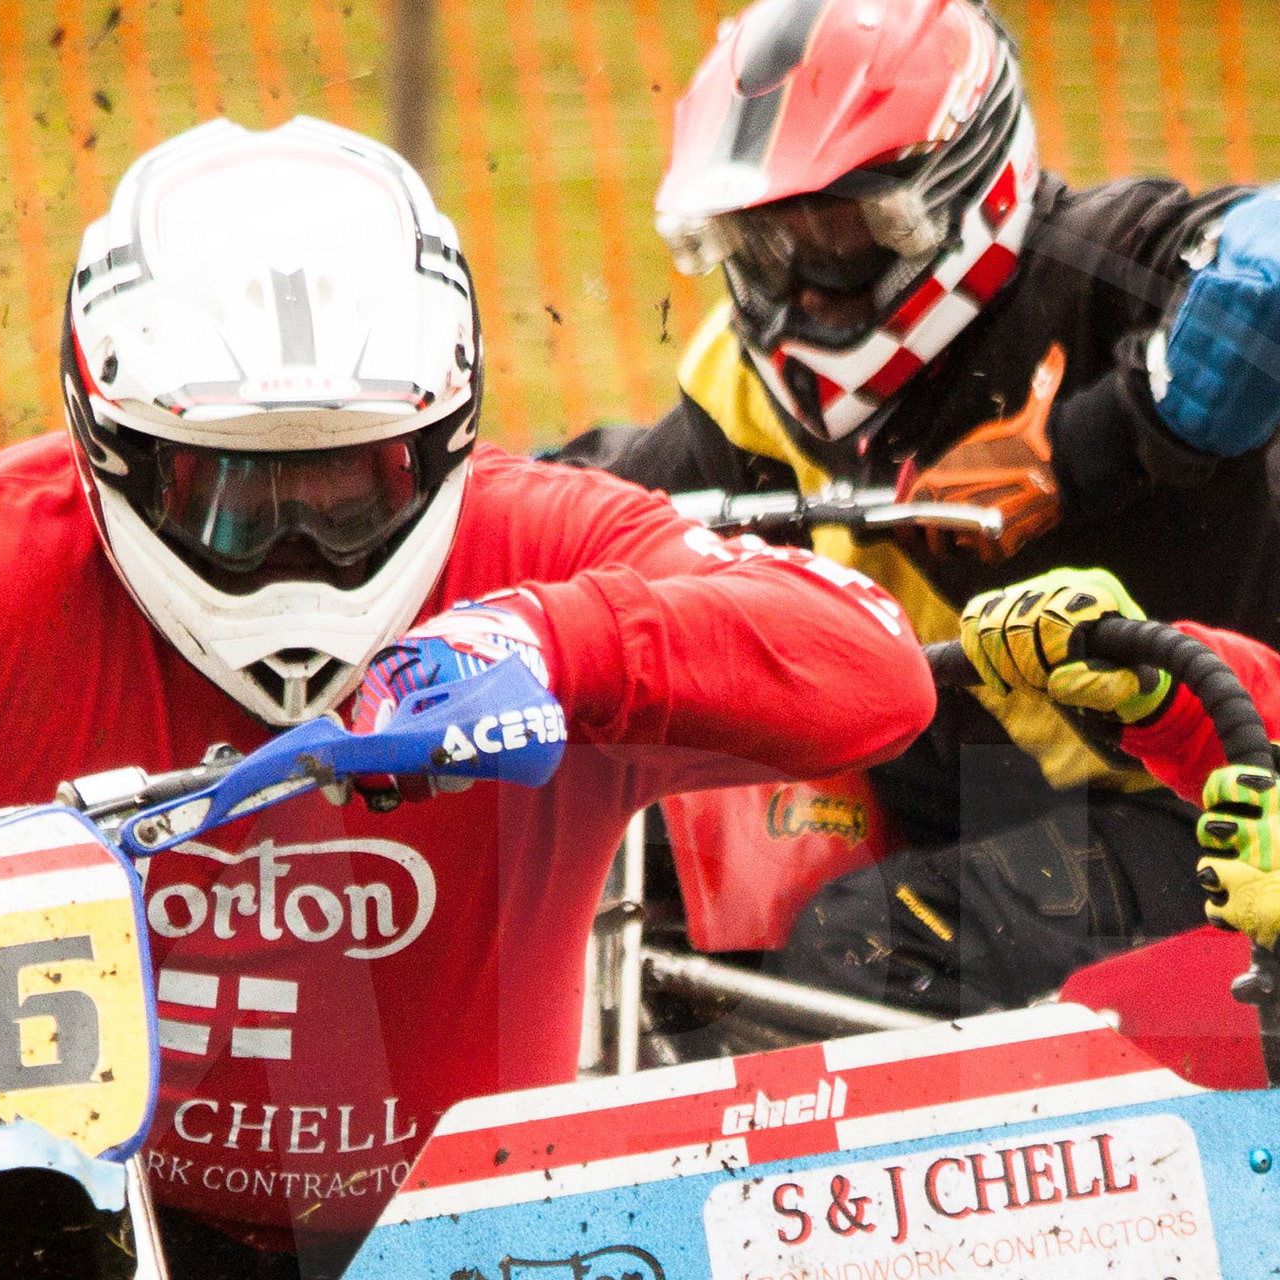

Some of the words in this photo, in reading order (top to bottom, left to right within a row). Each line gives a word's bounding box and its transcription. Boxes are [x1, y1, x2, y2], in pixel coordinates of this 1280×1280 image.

[442, 703, 567, 765] ACERBI
[136, 837, 437, 960] orton
[174, 1097, 418, 1155] CHELL
[721, 1075, 848, 1138] chell
[201, 1160, 411, 1199] CONTRACTO
[771, 1182, 813, 1246] S
[825, 1174, 876, 1238] &
[883, 1166, 910, 1244] J
[924, 1133, 1138, 1222] CHELL
[972, 1211, 1199, 1270] CONTRACTORS
